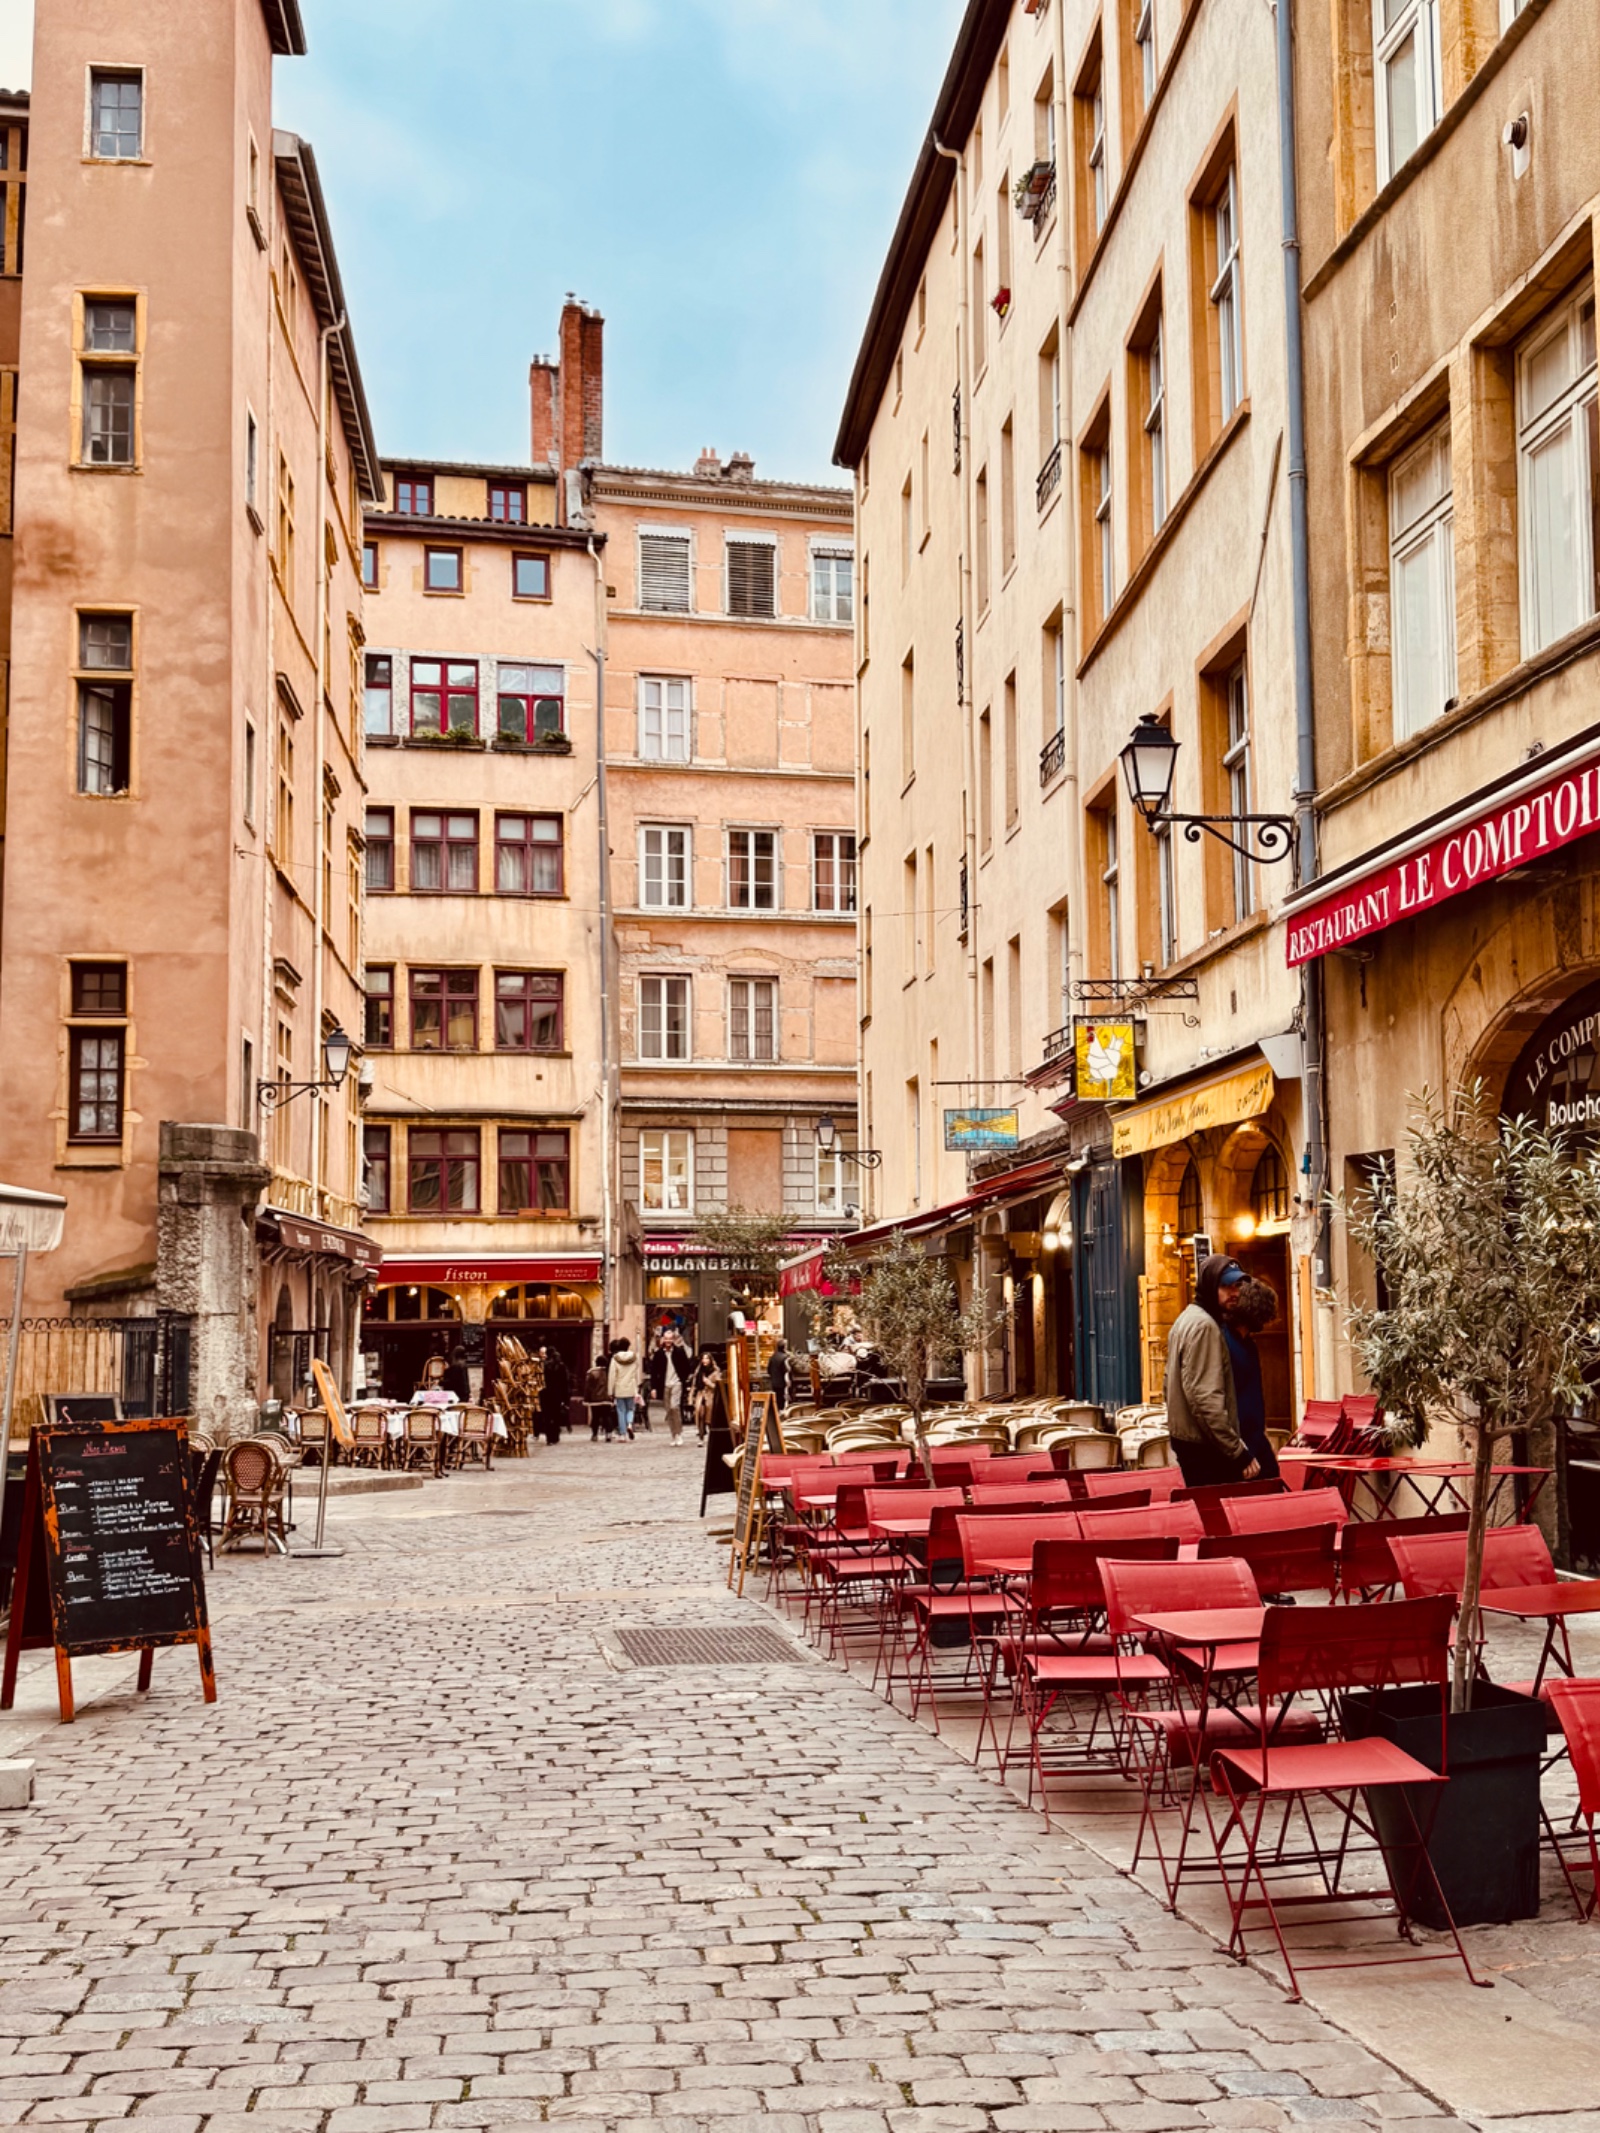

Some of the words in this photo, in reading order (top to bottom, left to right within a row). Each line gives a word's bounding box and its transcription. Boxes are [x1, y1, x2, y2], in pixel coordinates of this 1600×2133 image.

[1288, 885, 1391, 962] RESTAURANT
[1398, 852, 1434, 912] LE
[1442, 765, 1600, 889] COMPTOI
[1525, 1053, 1548, 1096] LE
[443, 1268, 487, 1281] fiston
